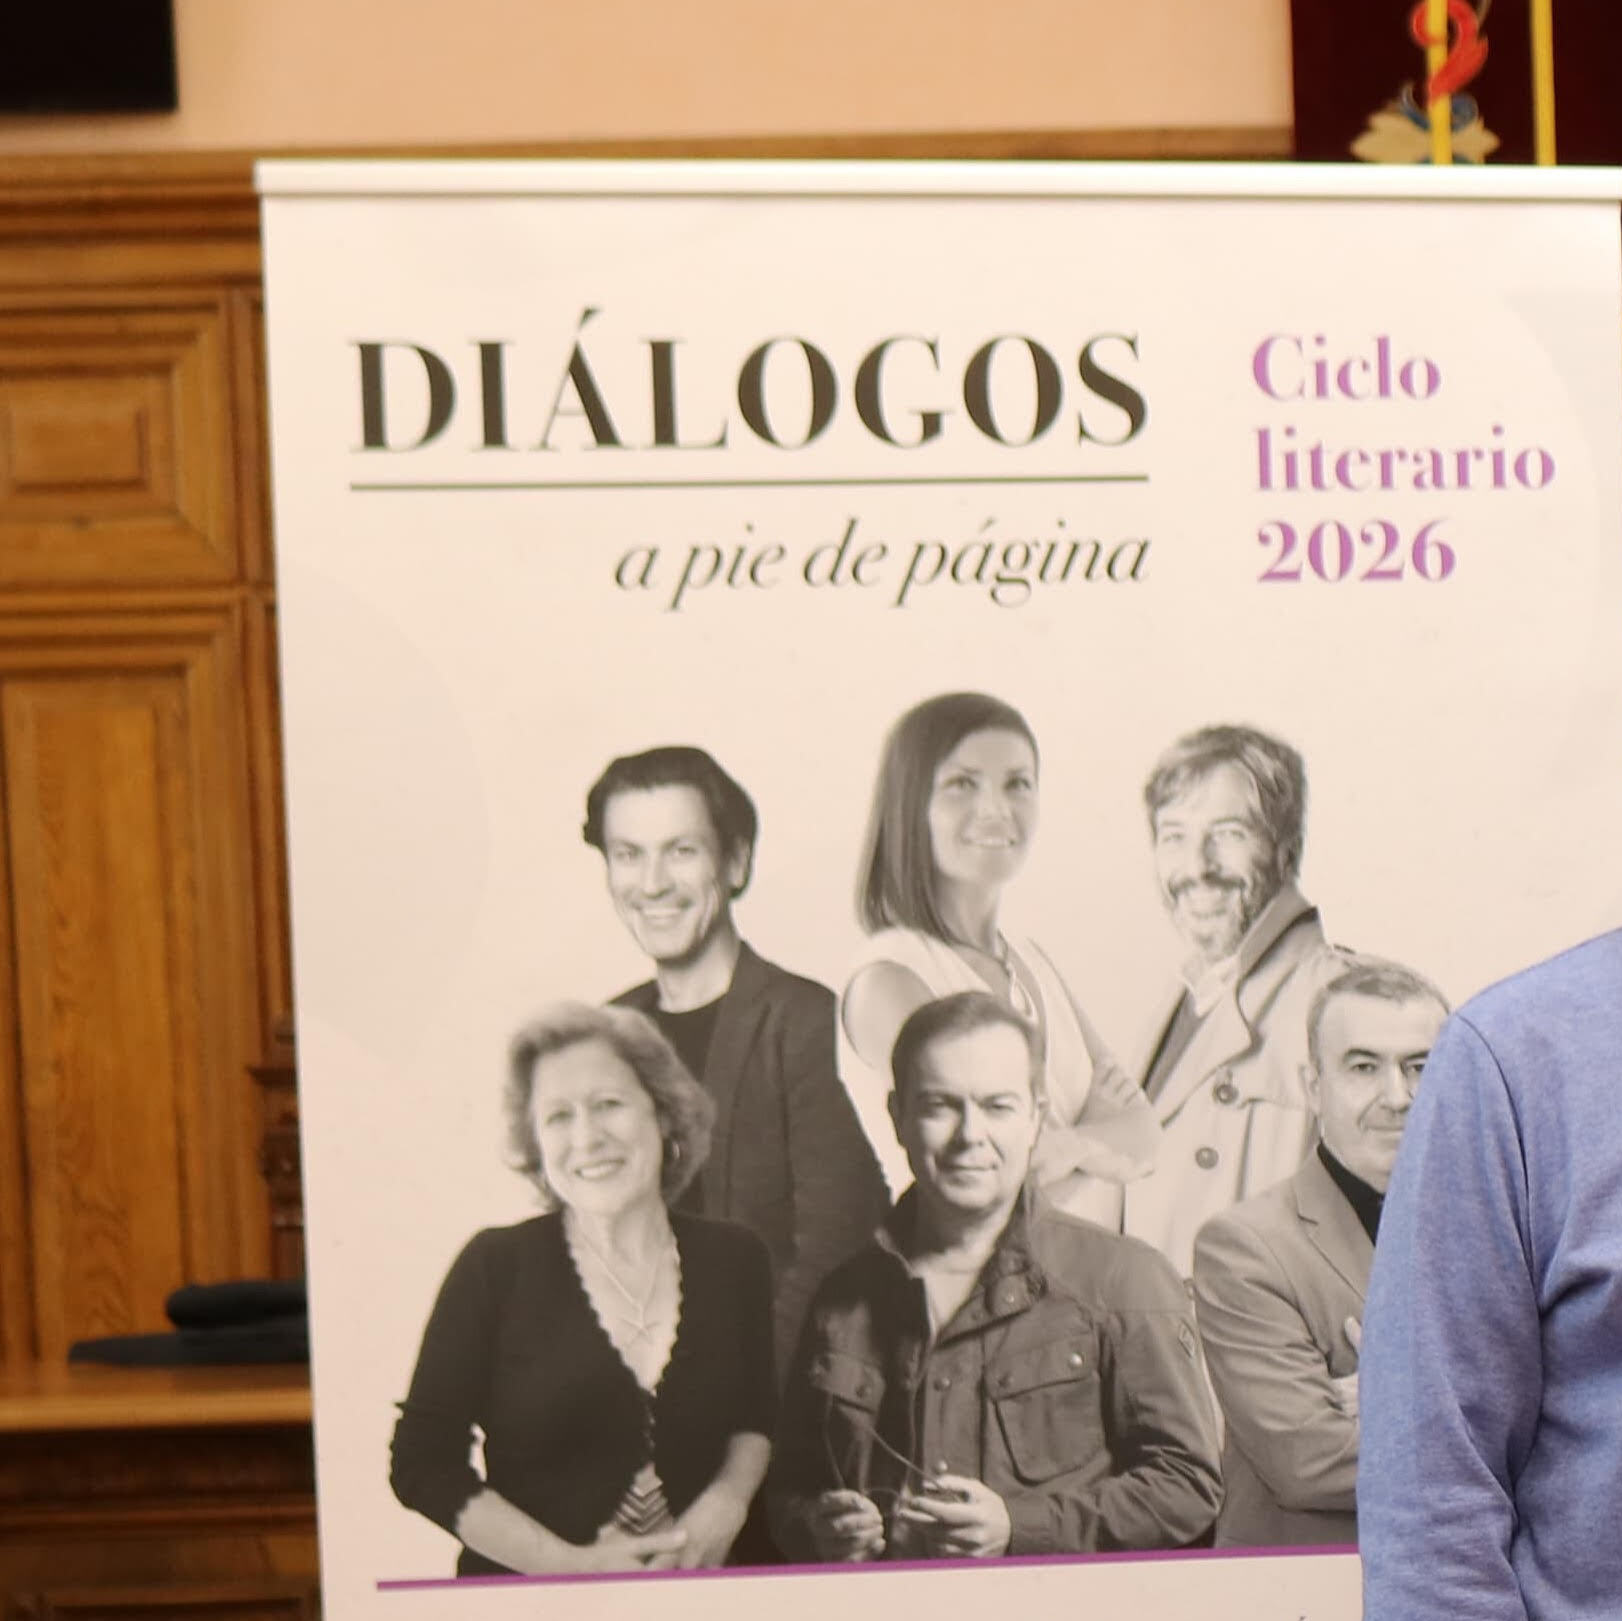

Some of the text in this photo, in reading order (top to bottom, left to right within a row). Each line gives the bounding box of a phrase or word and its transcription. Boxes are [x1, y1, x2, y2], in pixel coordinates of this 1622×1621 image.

[348, 306, 1148, 452] DIÁLOGOS
[1251, 335, 1441, 400] Ciclo
[1256, 425, 1555, 492] literario
[614, 517, 1152, 613] a pie de página
[1257, 519, 1456, 583] 2026
